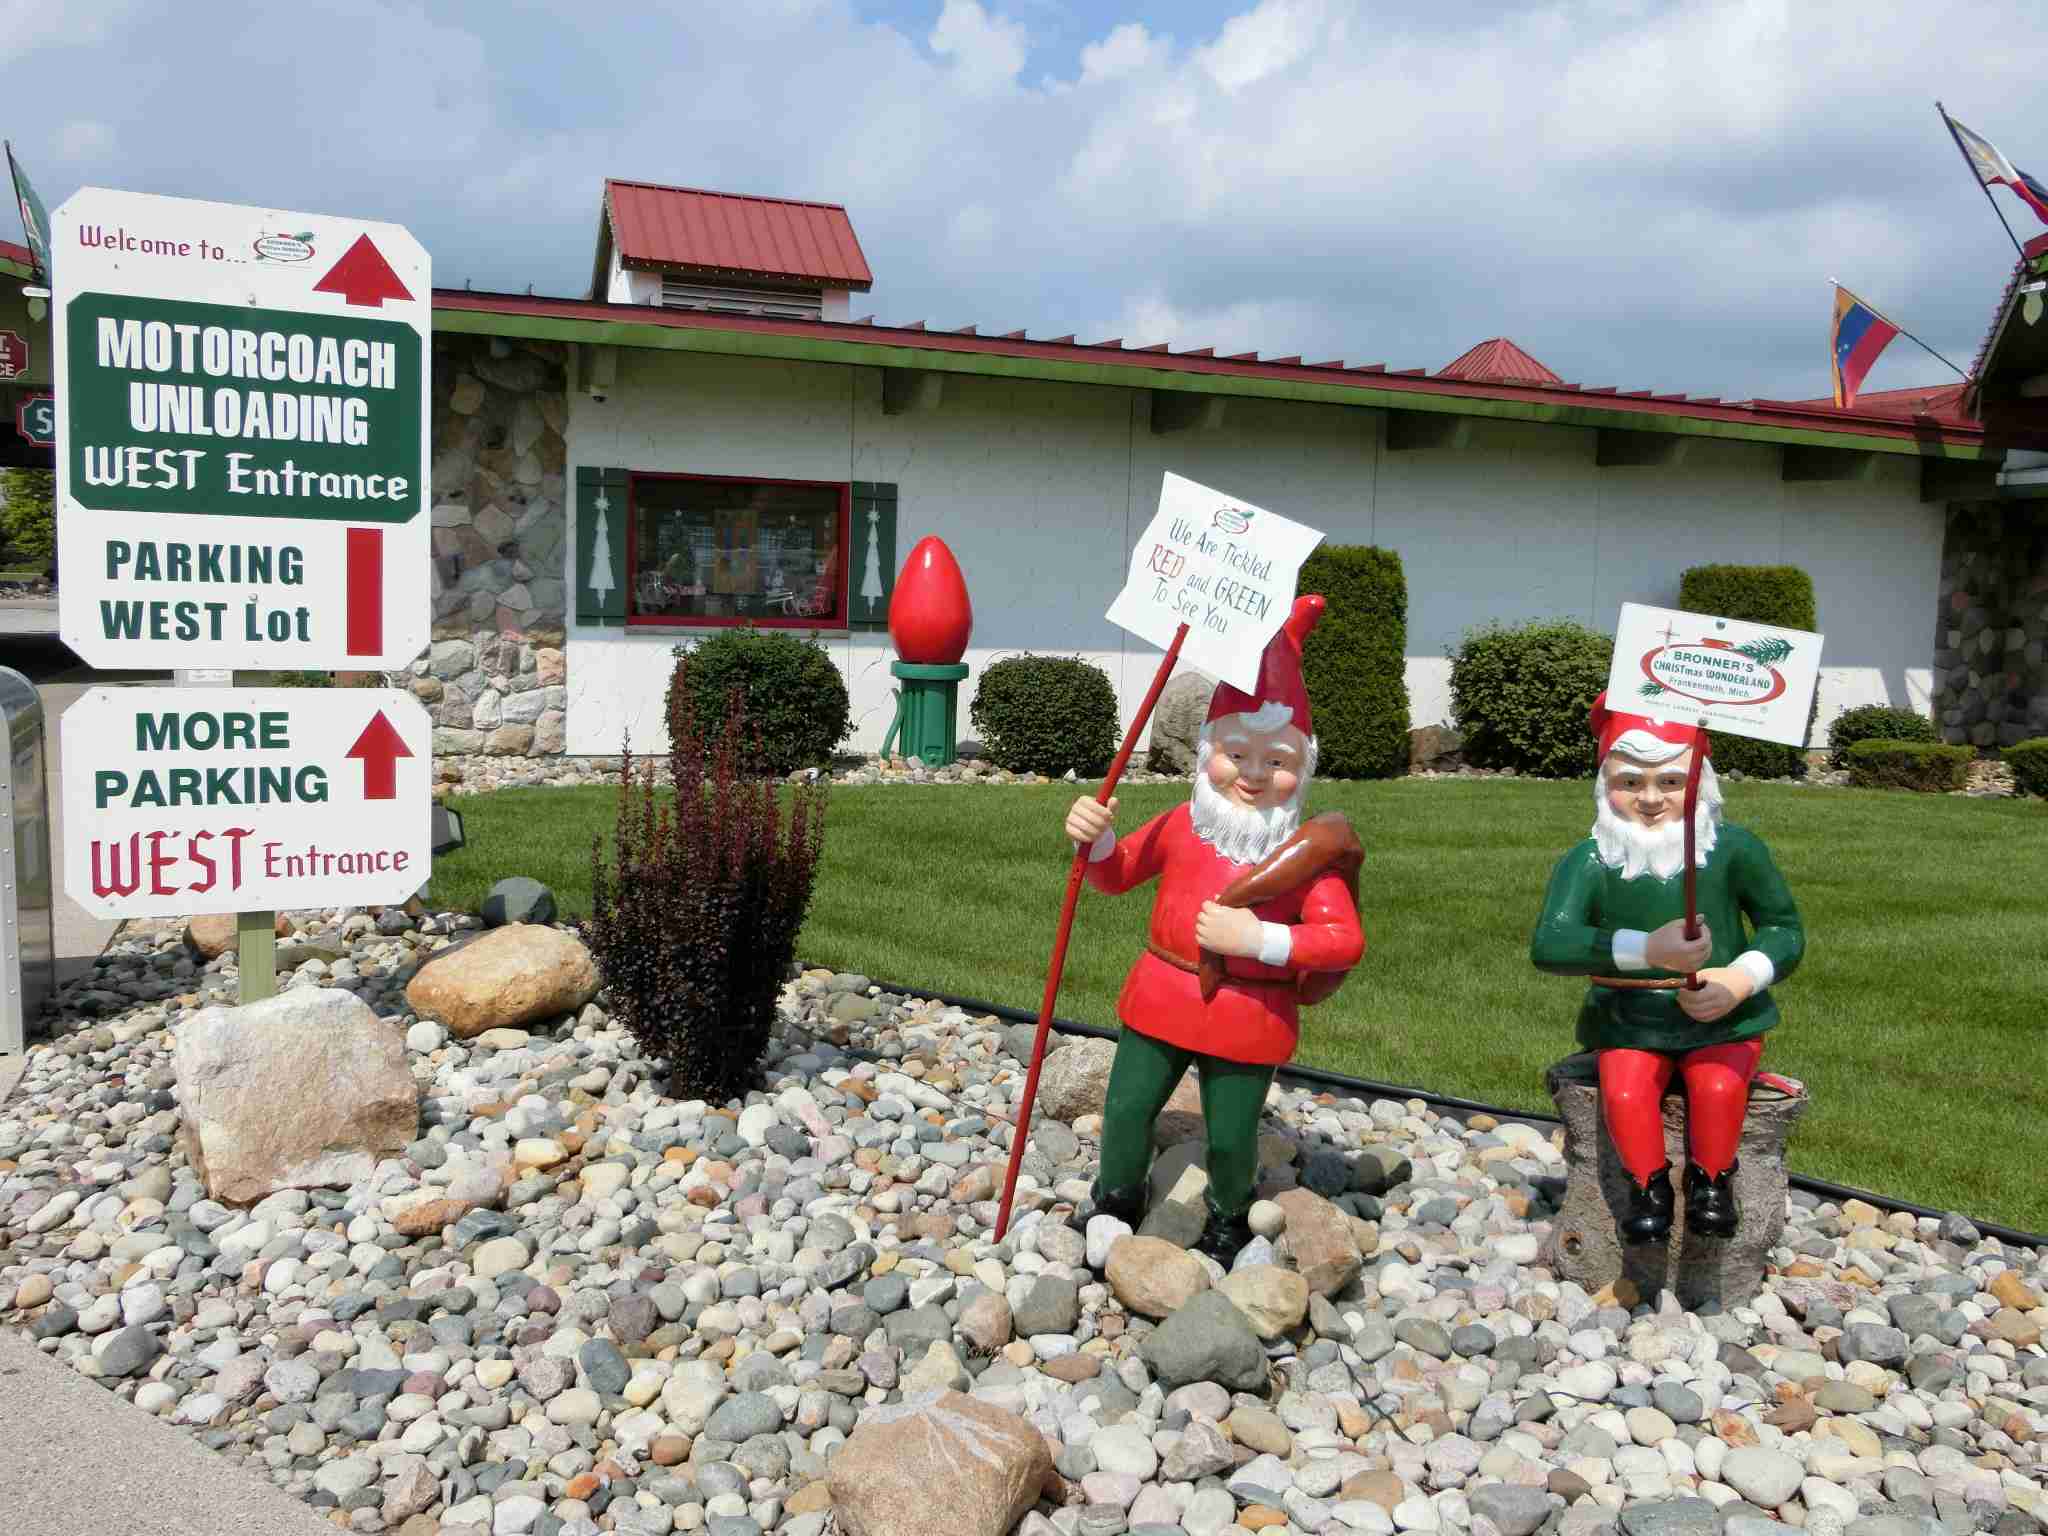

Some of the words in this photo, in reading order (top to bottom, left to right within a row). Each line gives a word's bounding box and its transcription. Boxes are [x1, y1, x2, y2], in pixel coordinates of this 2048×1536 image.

[80, 224, 191, 257] Welcome
[97, 317, 397, 390] MOTORCOACH
[129, 382, 369, 446] UNLOADING
[84, 446, 207, 490] WEST
[225, 452, 409, 501] Entrance
[106, 540, 304, 585] PARKING
[1169, 518, 1192, 545] We
[1197, 532, 1218, 556] Are
[1222, 542, 1272, 581] Tickled
[1145, 543, 1185, 579] RED
[1186, 574, 1211, 595] and
[1215, 576, 1273, 622] GREEN
[1152, 577, 1169, 602] To
[1172, 588, 1199, 617] See
[1204, 604, 1229, 634] You
[100, 600, 228, 641] WEST
[245, 602, 312, 642] Lot
[1654, 660, 1703, 678] CHRISTmas
[1706, 670, 1771, 689] WONDERLAND
[1674, 651, 1754, 673] BRONNER'S
[136, 711, 290, 752] MORE
[95, 765, 329, 809] PARKING
[91, 827, 256, 898] WEST
[263, 841, 409, 878] Entrance
